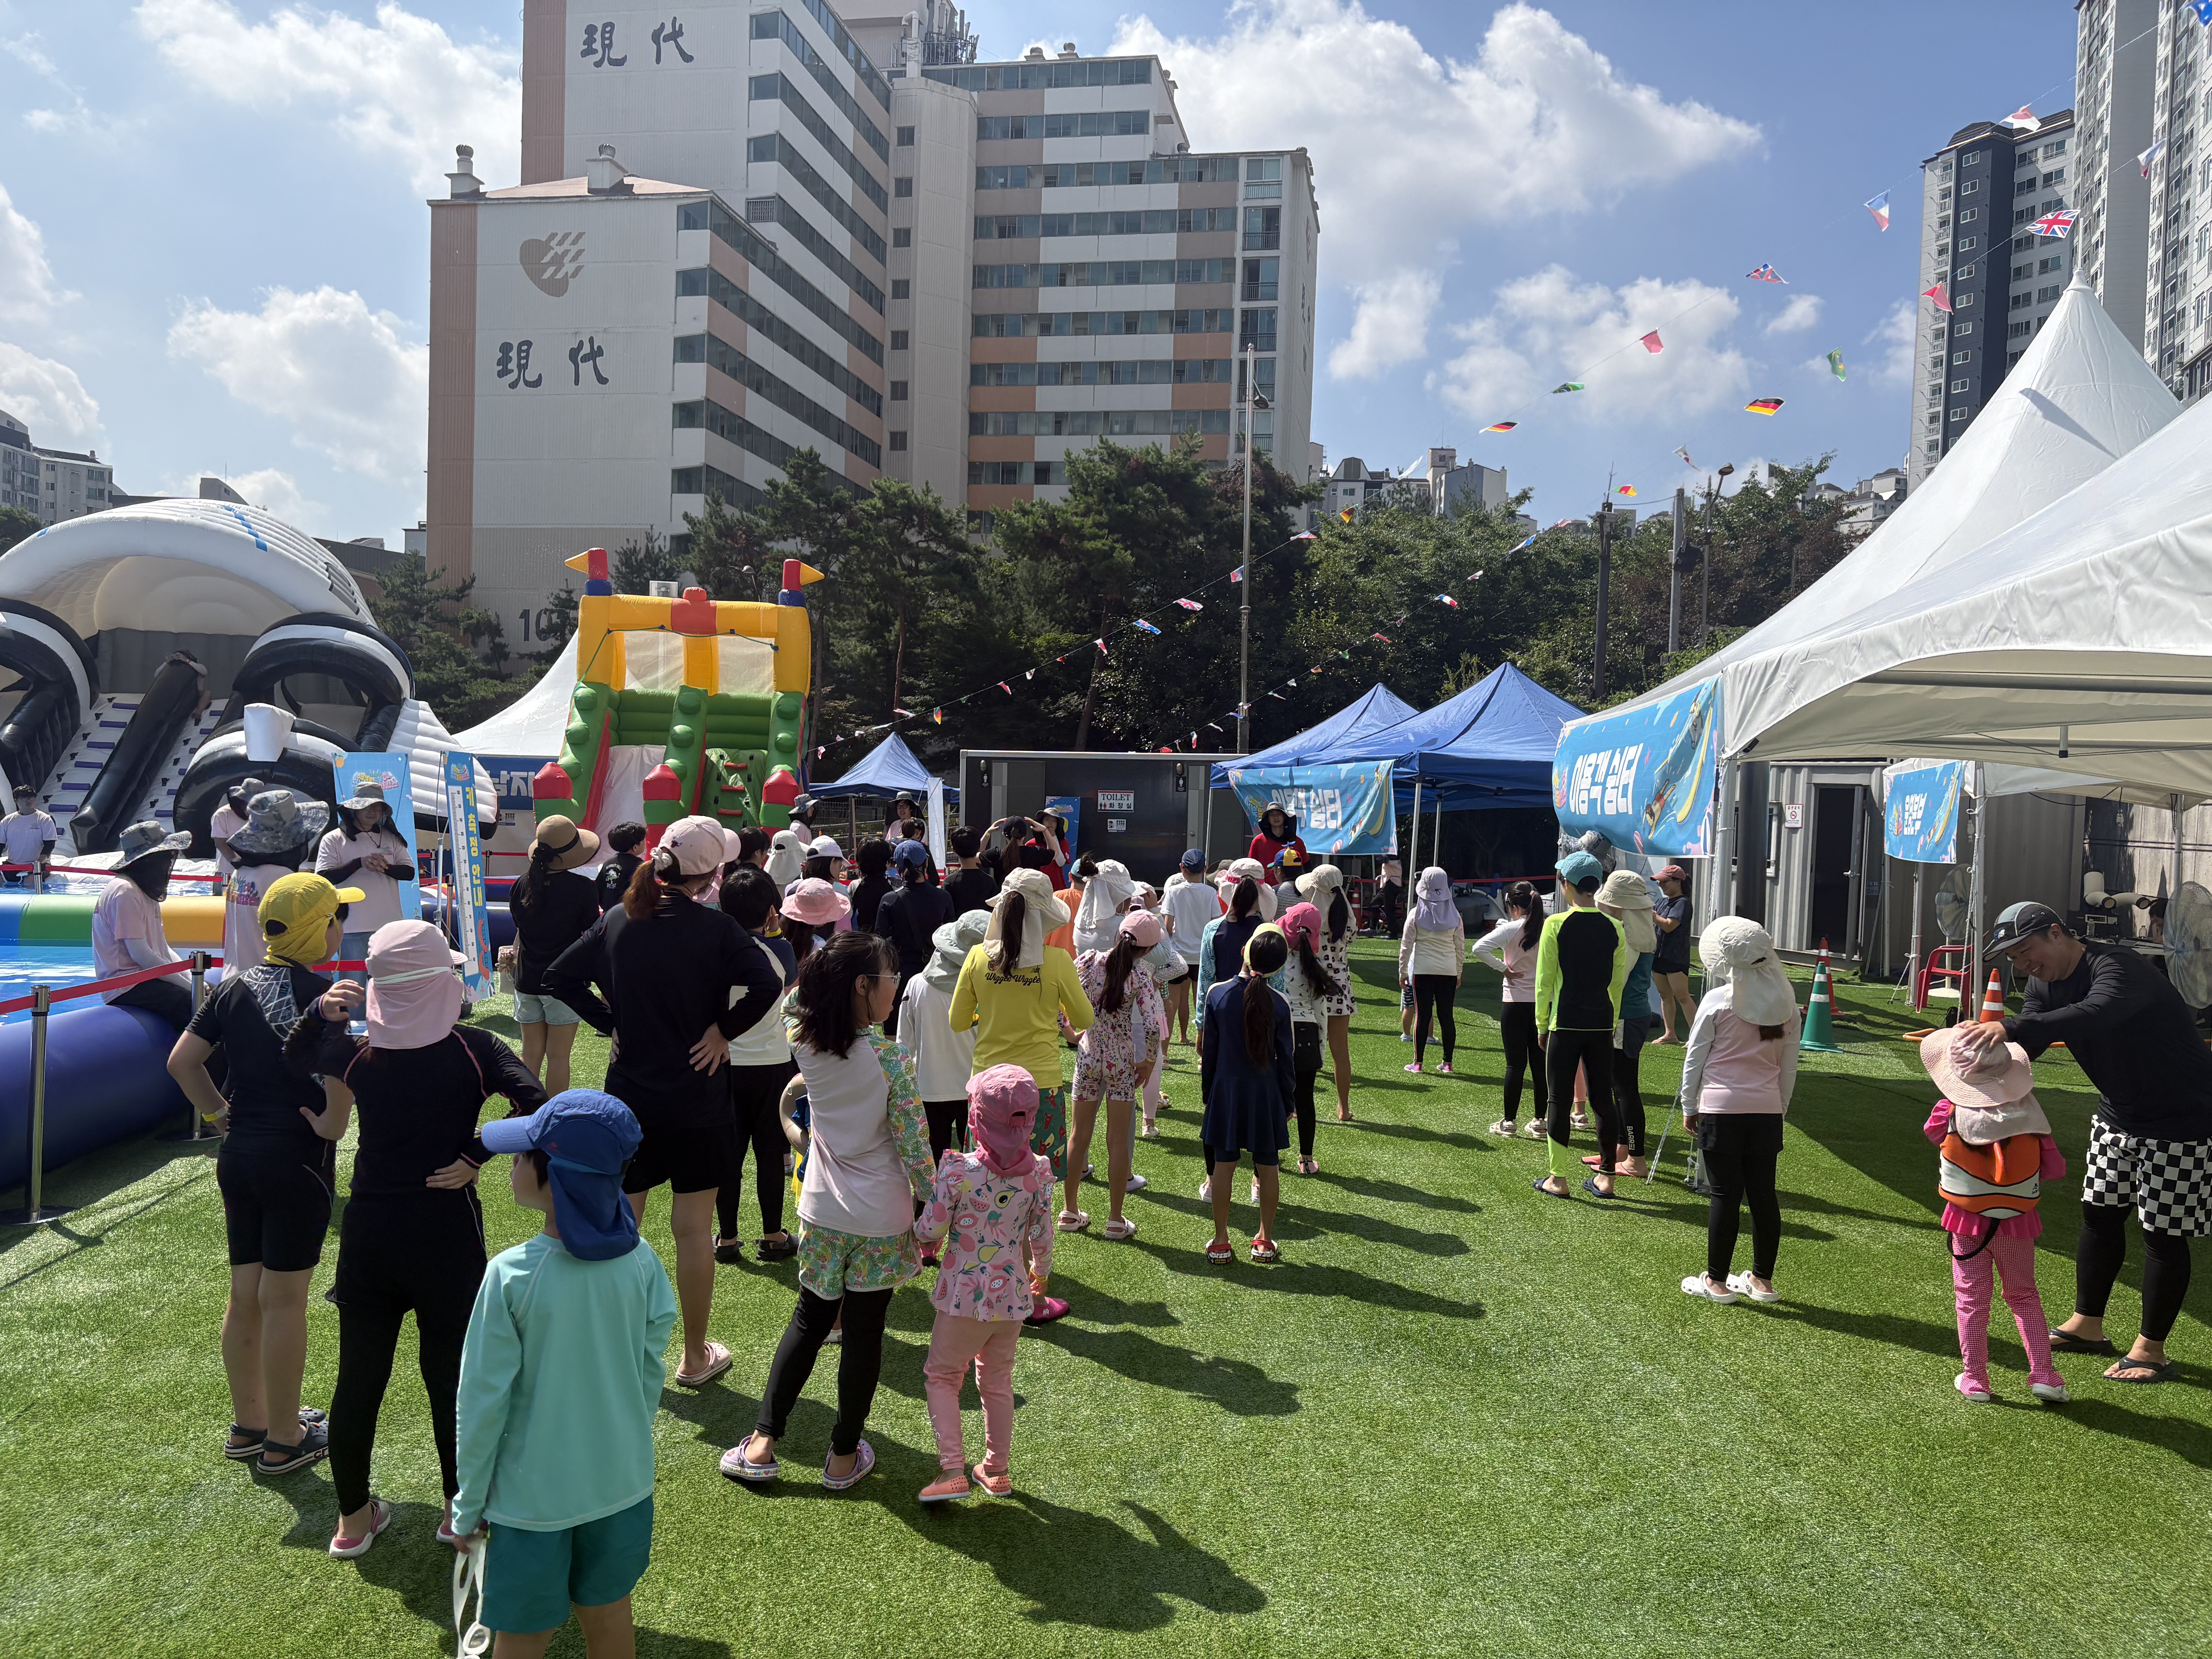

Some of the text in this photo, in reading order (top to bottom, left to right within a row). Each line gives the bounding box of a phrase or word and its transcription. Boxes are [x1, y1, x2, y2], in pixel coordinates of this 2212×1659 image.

[580, 16, 694, 68] 現代
[496, 336, 610, 390] 現代
[465, 787, 475, 807] 키
[1569, 749, 1610, 815] 이용객
[1604, 742, 1644, 815] 쉼터
[1310, 788, 1343, 831] 쉼터
[468, 813, 479, 857] 측정
[472, 864, 483, 907] 안내
[1012, 974, 1041, 986] Wiggle
